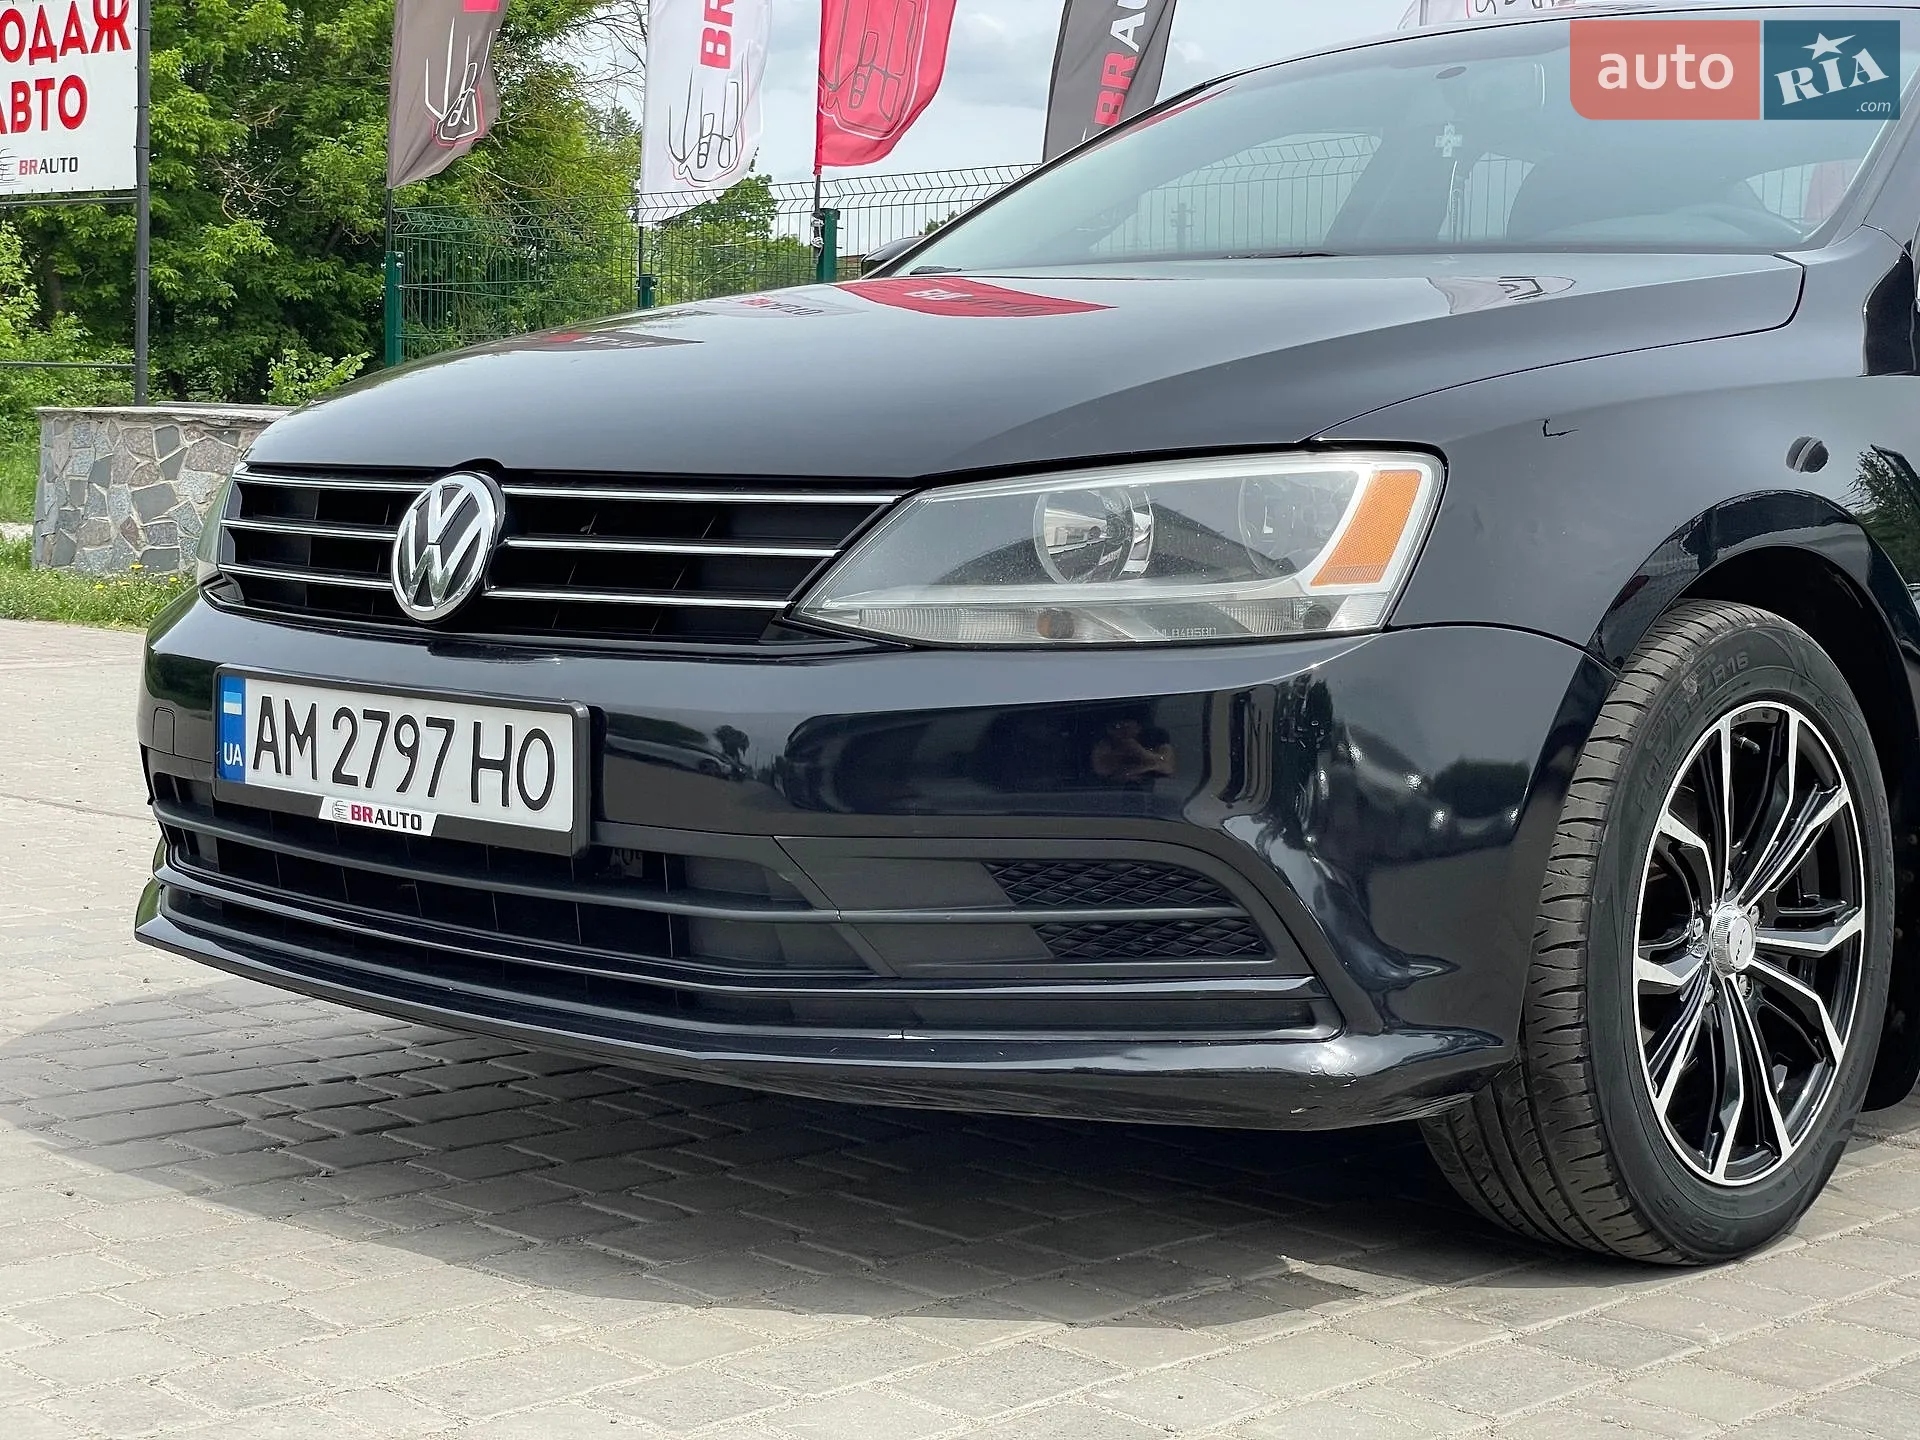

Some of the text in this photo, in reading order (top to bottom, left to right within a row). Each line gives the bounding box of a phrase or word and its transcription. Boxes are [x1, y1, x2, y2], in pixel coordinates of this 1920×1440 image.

[1094, 0, 1148, 127] BRA
[0, 74, 88, 134] ВТО
[19, 156, 79, 176] BRAUTO
[223, 742, 243, 767] UA
[252, 695, 556, 812] AM 2797 HO
[350, 804, 423, 831] BRAUTO
